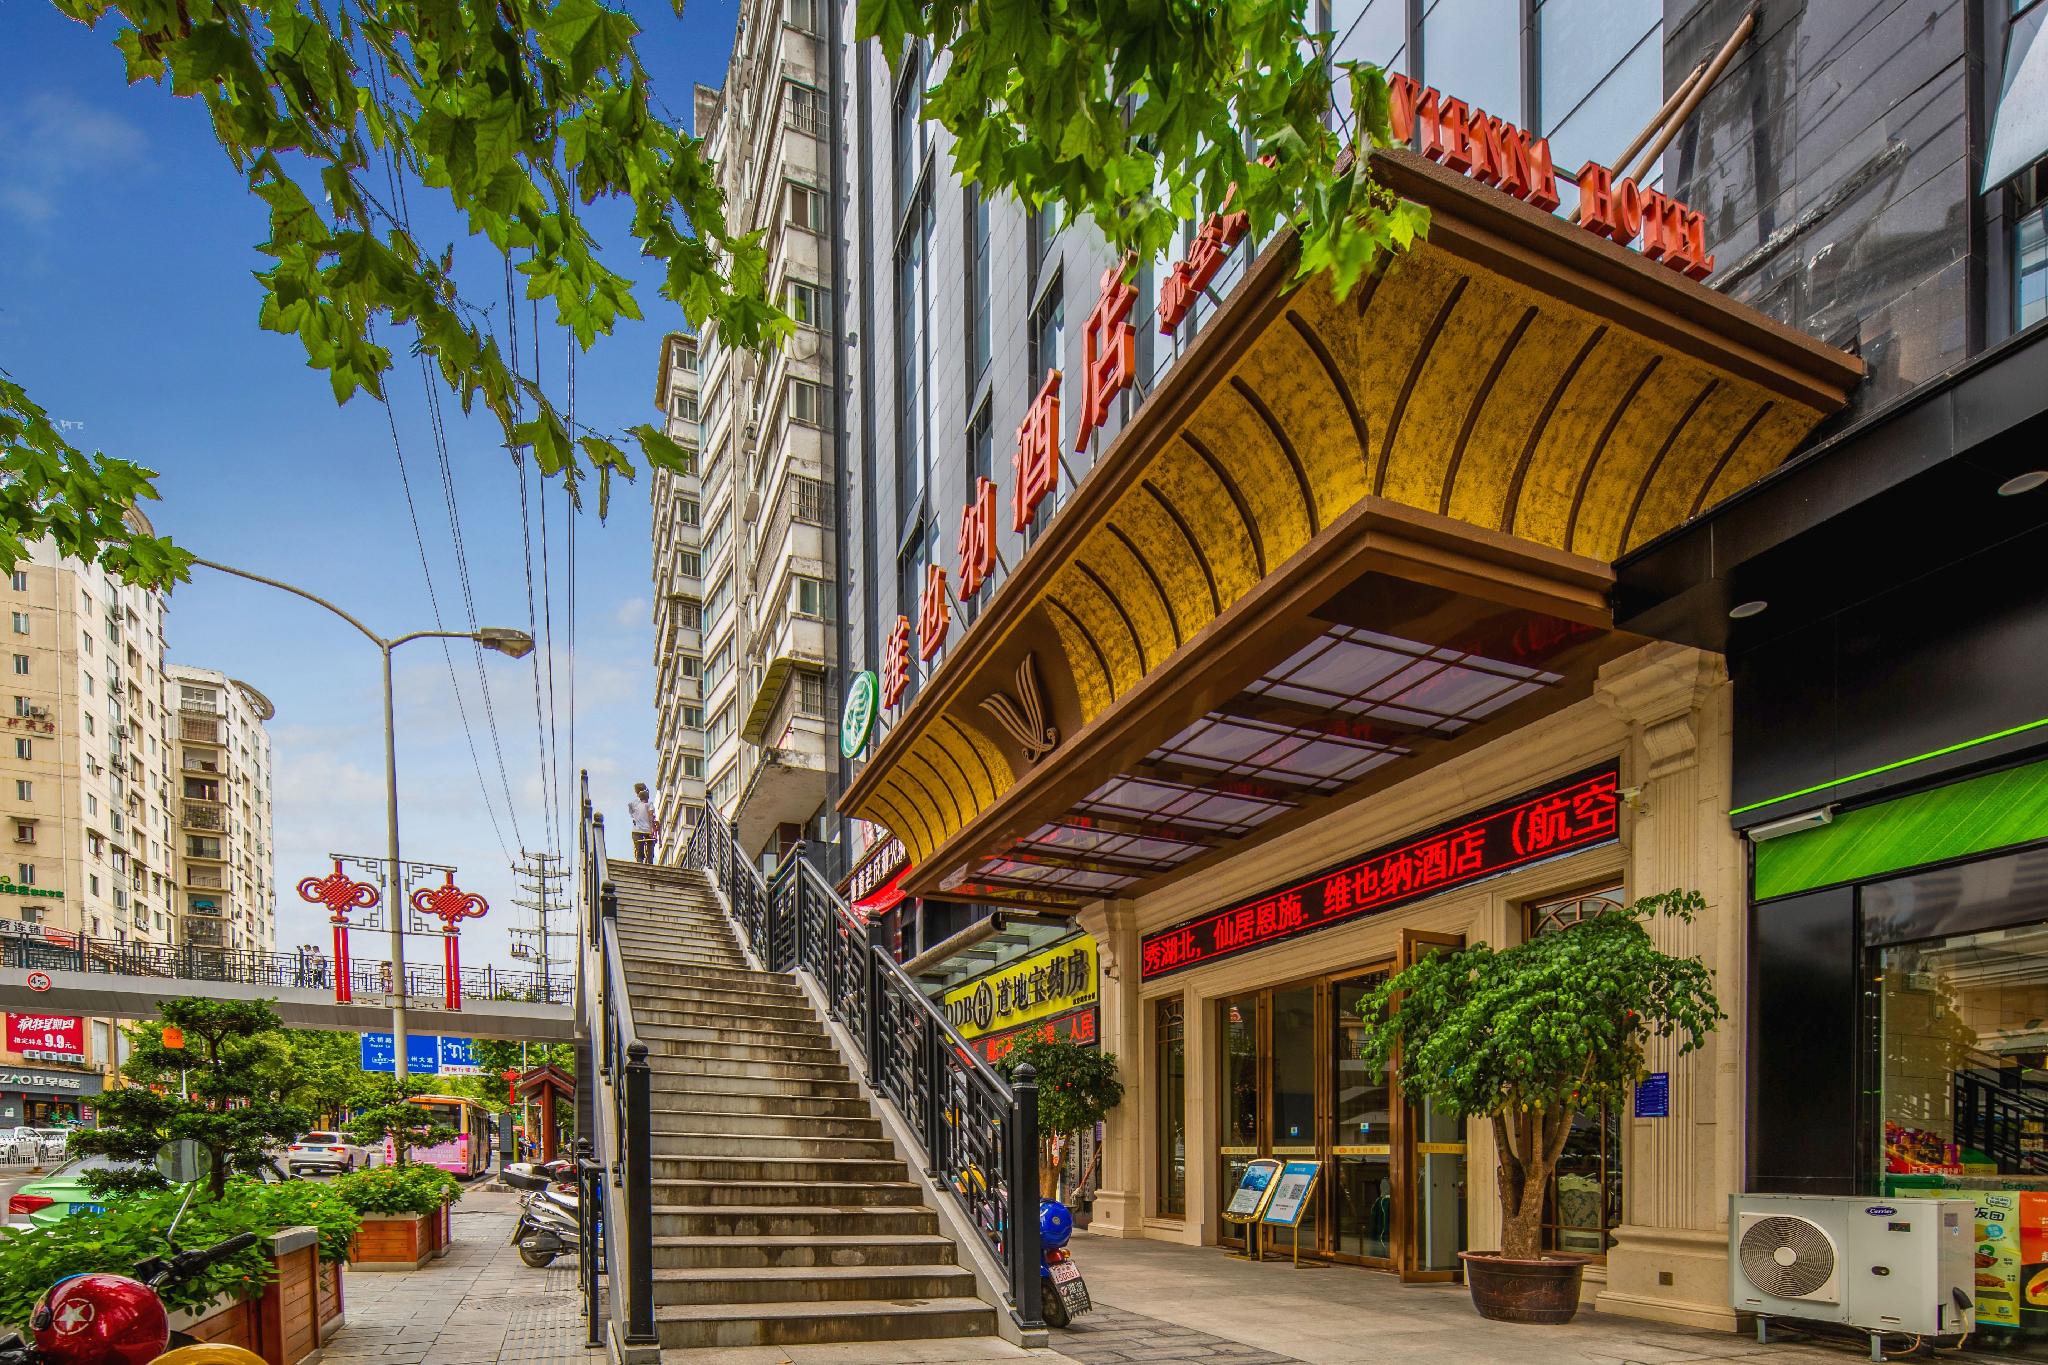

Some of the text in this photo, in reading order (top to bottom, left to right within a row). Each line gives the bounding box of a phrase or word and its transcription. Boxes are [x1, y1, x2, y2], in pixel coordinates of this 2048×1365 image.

[1388, 71, 1714, 282] VIENNA HOTEL
[884, 250, 1138, 709] 维也纳酒店
[996, 949, 1090, 1017] 道地宝药房
[17, 1016, 75, 1033] 疯狂星期四
[407, 1056, 434, 1064] 州大道
[2001, 1182, 2036, 1191] Today
